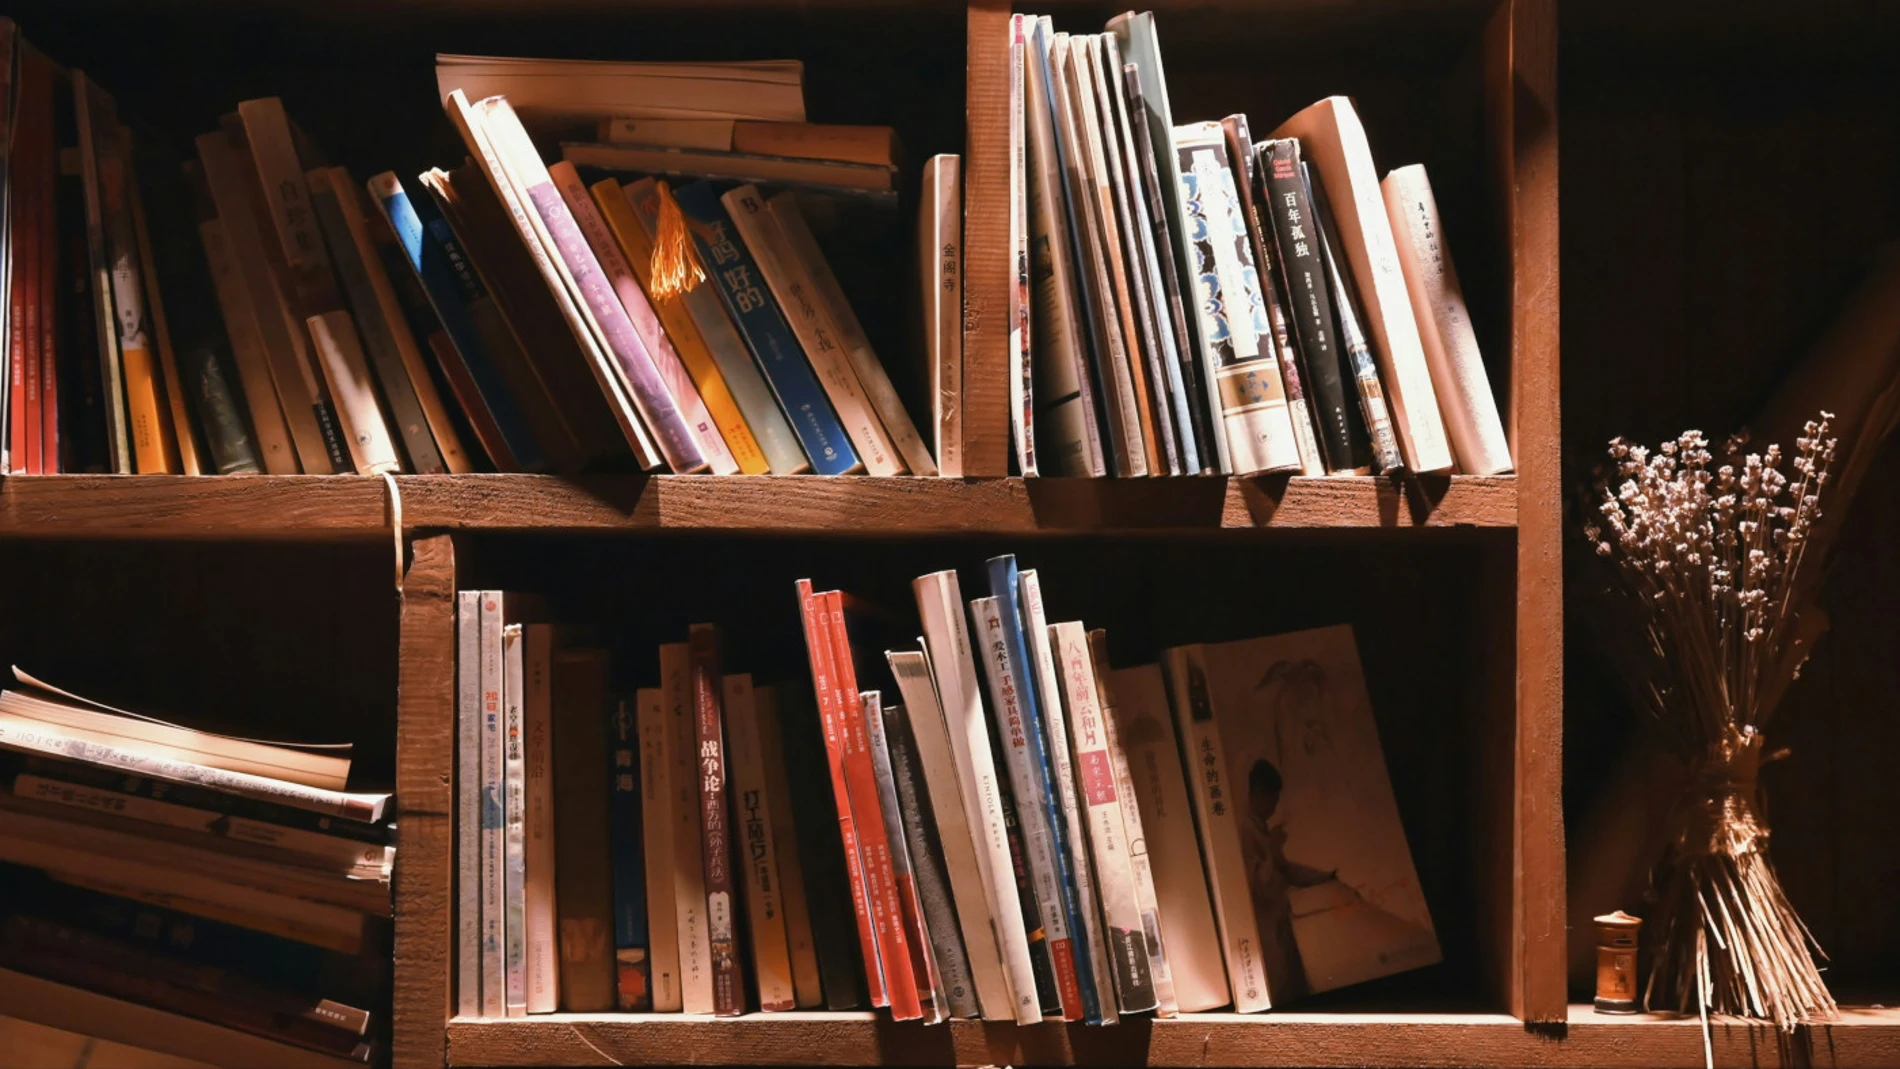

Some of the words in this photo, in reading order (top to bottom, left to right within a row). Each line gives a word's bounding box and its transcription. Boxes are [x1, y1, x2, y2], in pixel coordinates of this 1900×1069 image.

[1283, 192, 1310, 258] 百年孤独
[943, 243, 957, 292] 金阁寺
[992, 641, 1010, 671] 爱木工
[485, 691, 498, 711] 知日
[1068, 641, 1097, 746] 八百年前云和月
[531, 720, 544, 778] 文学前沿
[615, 749, 632, 792] 青海
[982, 775, 995, 815] KINFOLK
[1200, 737, 1226, 817] 生命的画卷
